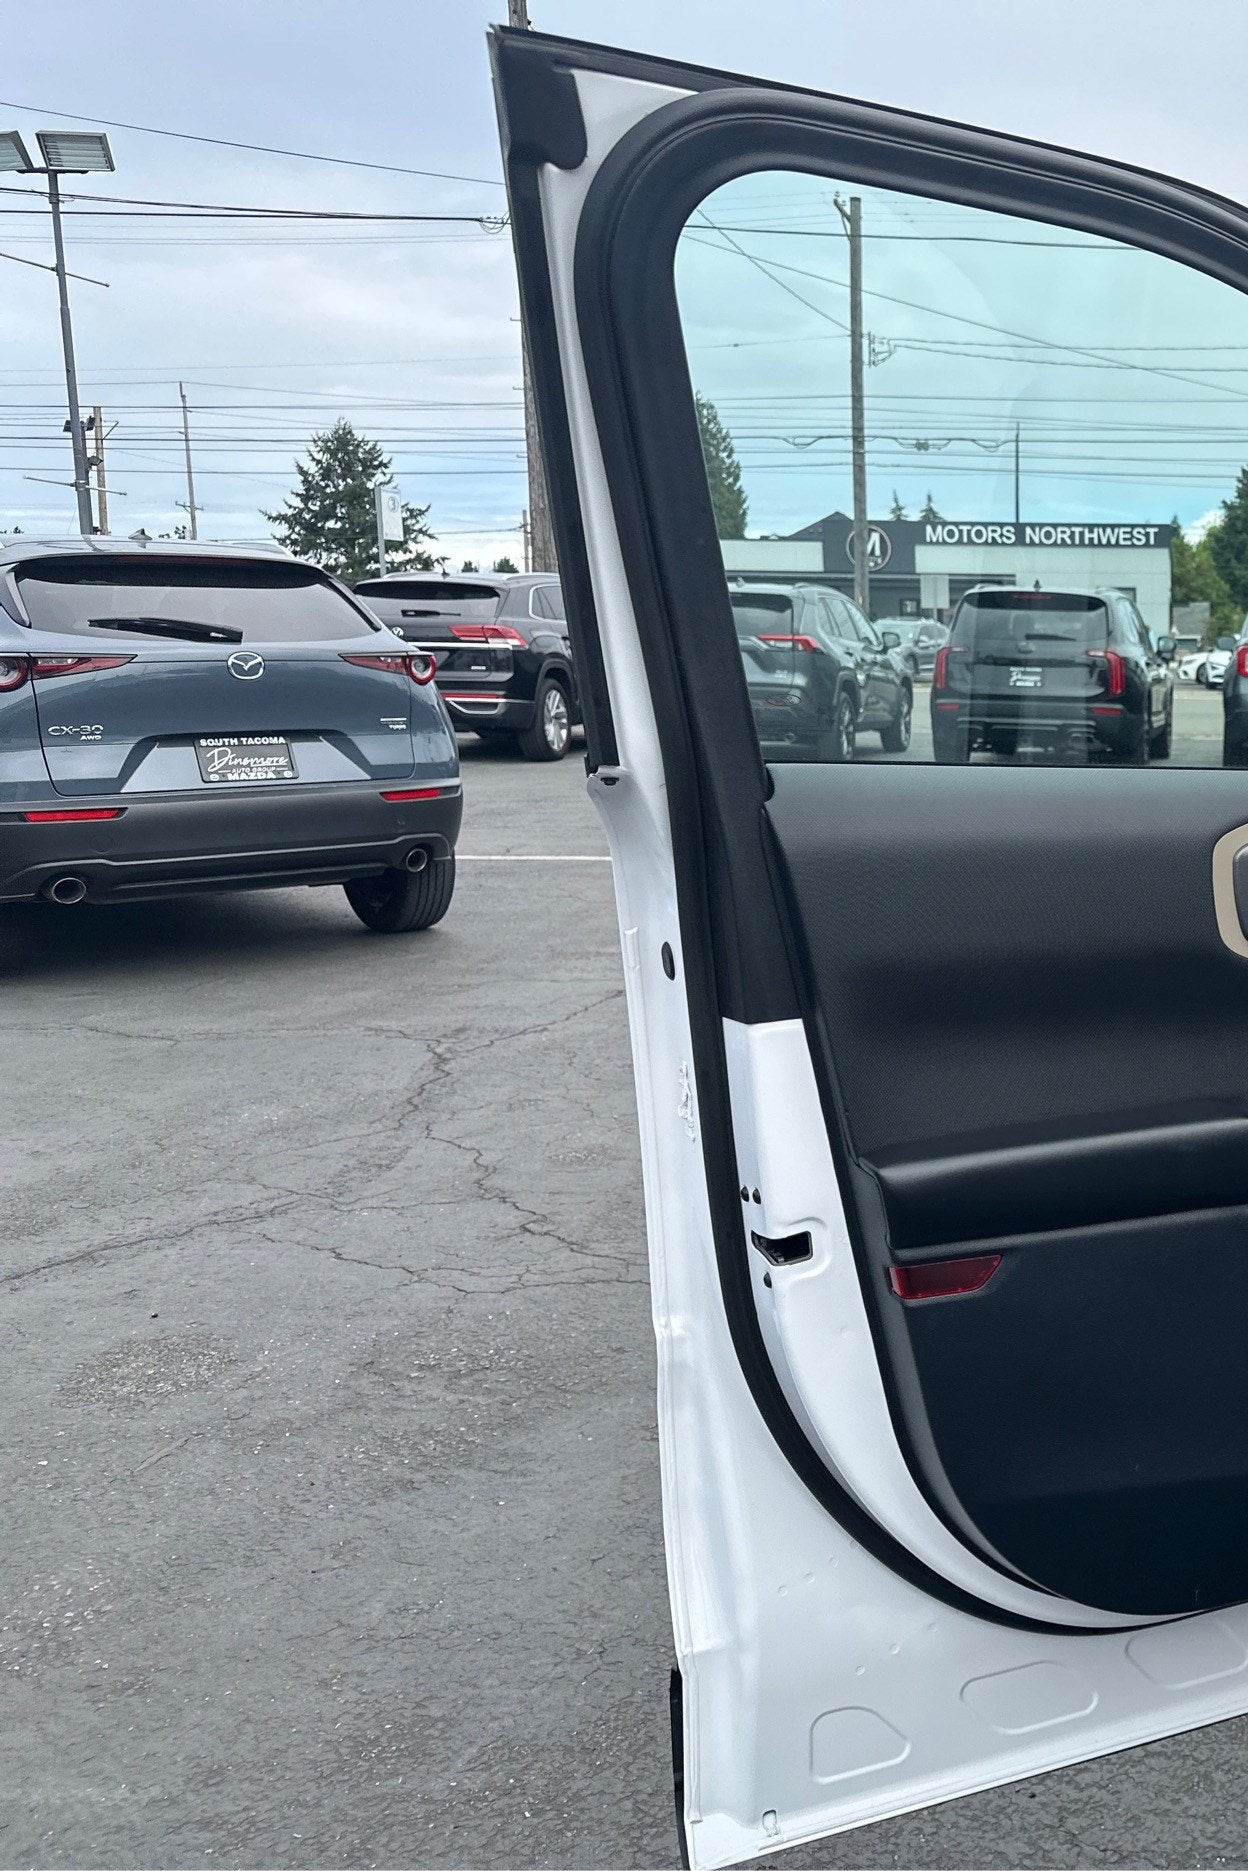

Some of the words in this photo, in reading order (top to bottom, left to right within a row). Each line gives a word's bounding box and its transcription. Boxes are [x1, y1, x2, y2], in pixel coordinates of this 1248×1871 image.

[925, 524, 1016, 544] MOTORS
[1025, 526, 1159, 546] NORTHWEST
[48, 725, 104, 735] CX-30
[200, 738, 239, 747] SOUTH
[241, 736, 286, 745] TACOMA
[206, 747, 289, 773] Dinsmore
[227, 771, 277, 781] MAZDA
